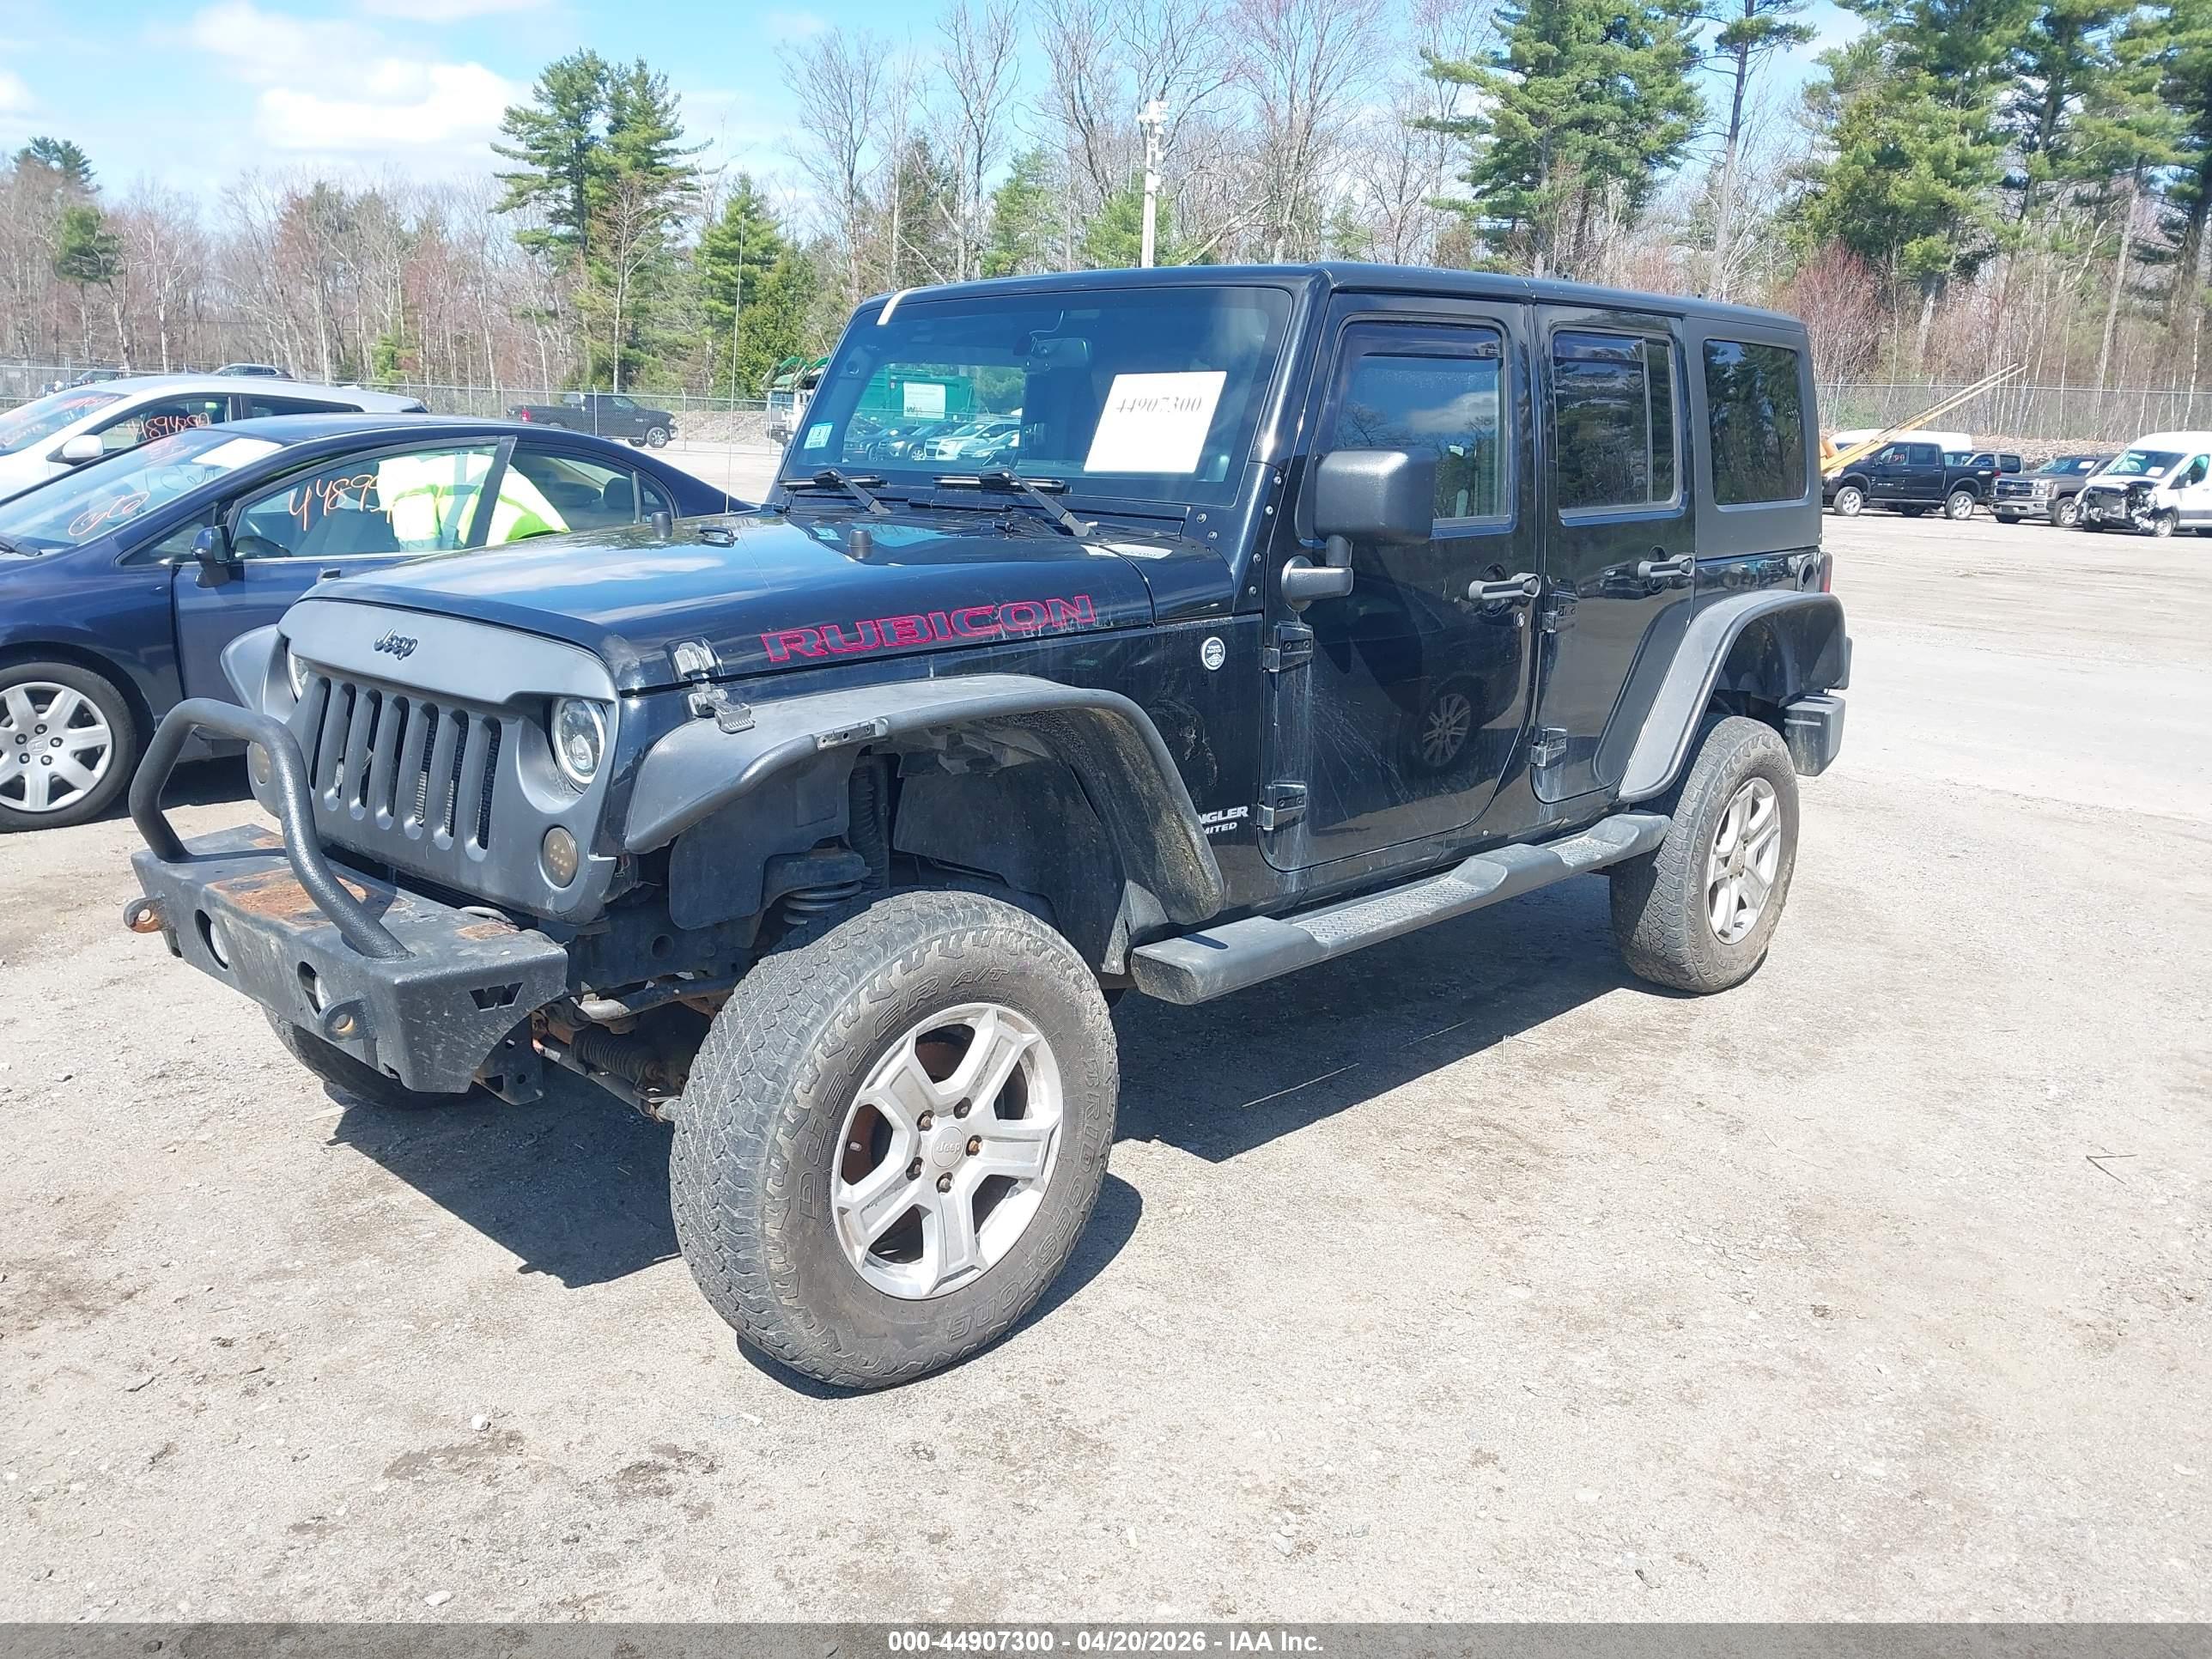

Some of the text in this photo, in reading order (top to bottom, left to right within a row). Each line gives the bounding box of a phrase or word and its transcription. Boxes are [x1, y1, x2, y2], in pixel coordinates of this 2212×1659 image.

[1115, 396, 1202, 413] 44907300
[761, 594, 1095, 662] RUBICON
[374, 628, 418, 660] Jeep
[936, 1141, 961, 1154] Jeep
